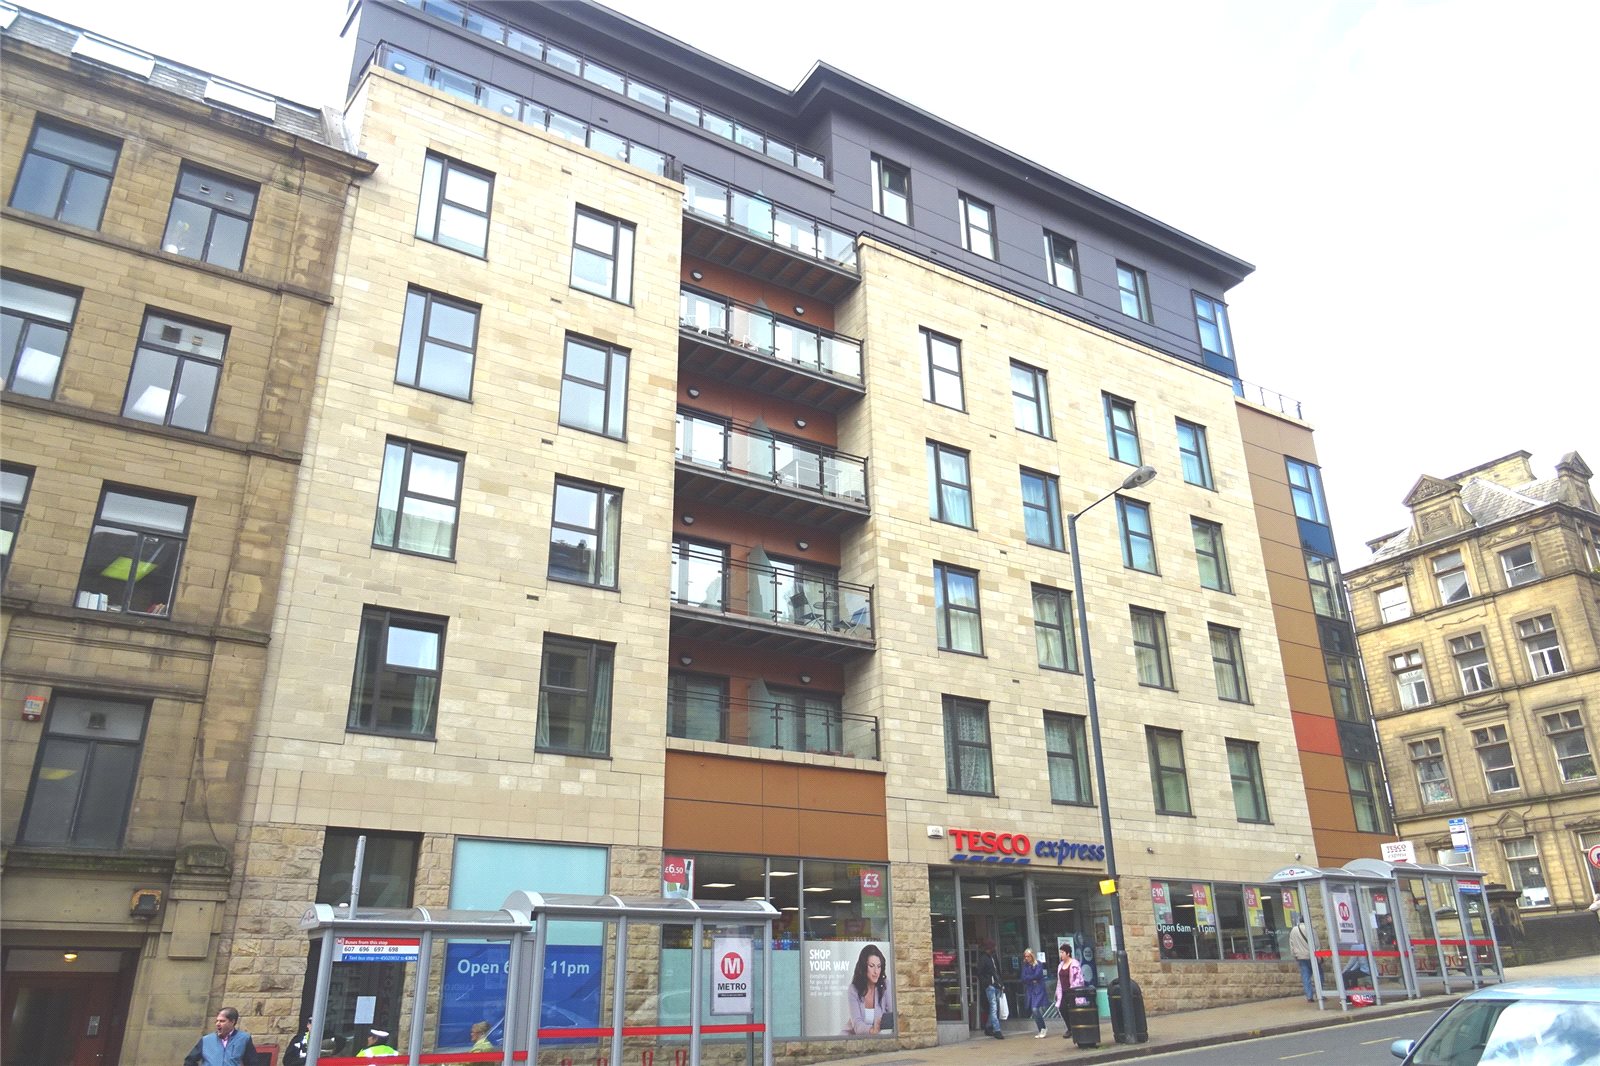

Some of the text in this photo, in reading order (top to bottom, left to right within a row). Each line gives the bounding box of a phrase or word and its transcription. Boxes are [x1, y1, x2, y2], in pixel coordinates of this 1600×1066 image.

[949, 829, 1105, 865] TESCO express
[665, 863, 684, 874] £6.50
[863, 873, 880, 888] £3
[1152, 887, 1164, 897] £10
[1283, 892, 1292, 903] £1
[1156, 923, 1176, 934] Open
[1176, 923, 1192, 933] 6am
[1198, 924, 1216, 935] 11pm
[809, 949, 831, 960] SHOP
[457, 959, 499, 976] Open
[551, 960, 590, 977] 11pm
[724, 957, 741, 974] M
[809, 960, 850, 971] YOUR WAY
[717, 983, 747, 991] METRO
